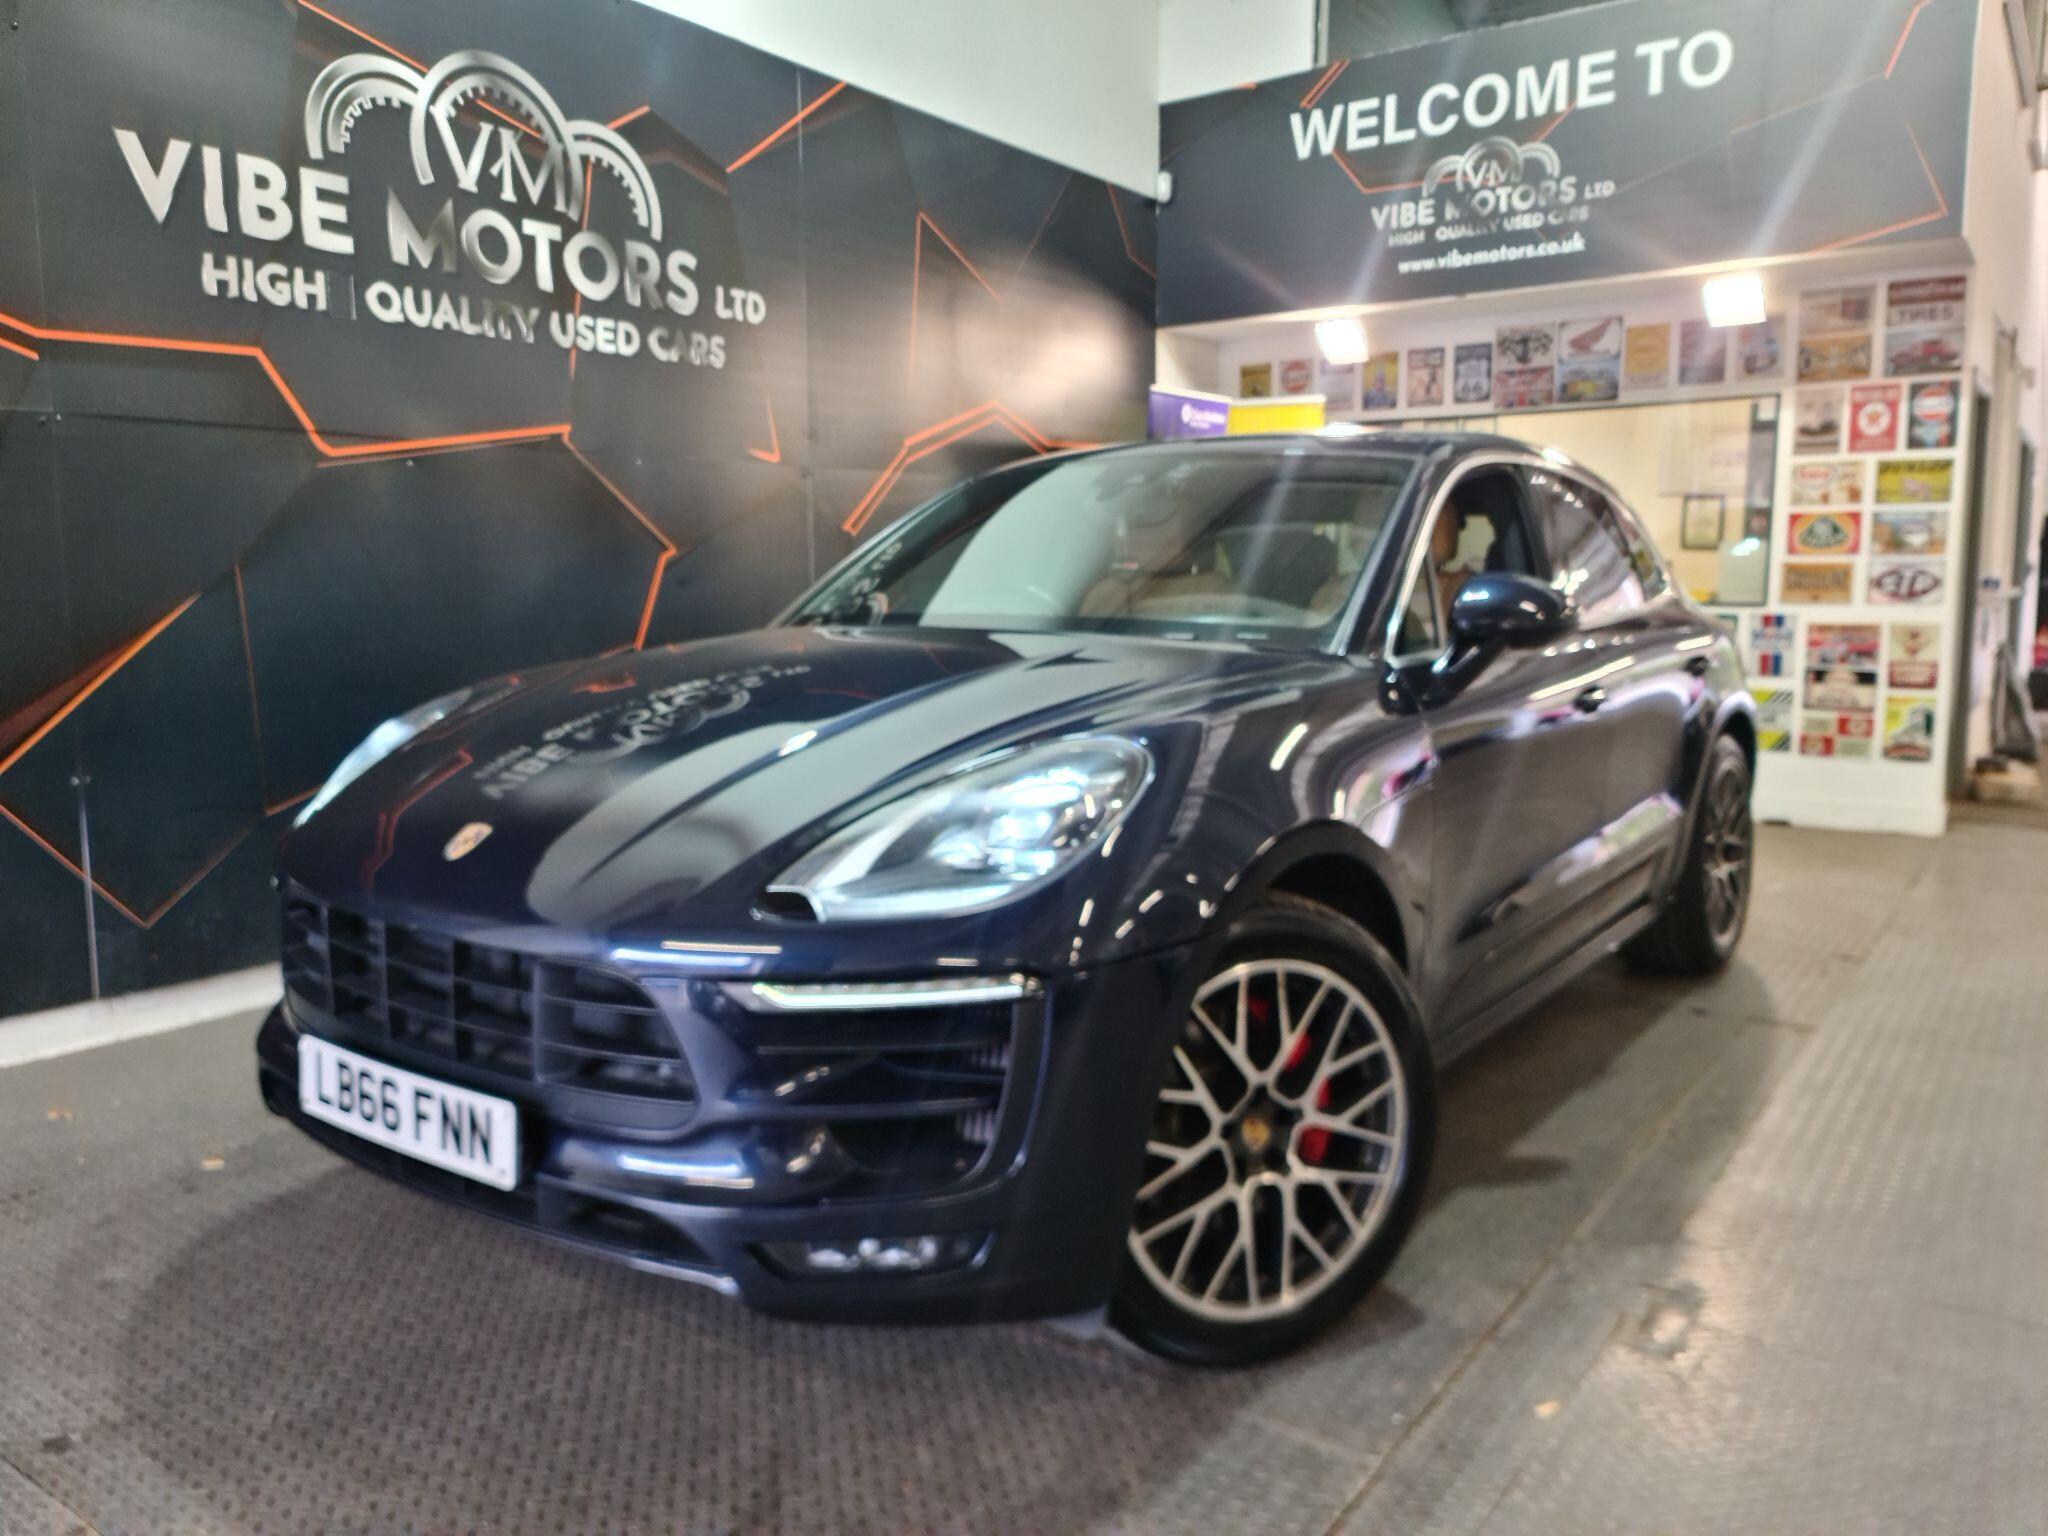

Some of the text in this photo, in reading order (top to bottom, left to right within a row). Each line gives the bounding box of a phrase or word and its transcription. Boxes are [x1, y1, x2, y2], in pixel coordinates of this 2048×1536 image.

[1290, 29, 1734, 161] WELCOME TO
[114, 127, 767, 325] VIBE MOTORS LTD
[1371, 198, 1436, 231] VIBE
[1398, 231, 1586, 274] www.vibemotors.co.uk
[201, 252, 726, 370] HIGH QUALITY USED CARS
[316, 1050, 492, 1165] LB66 FNN
